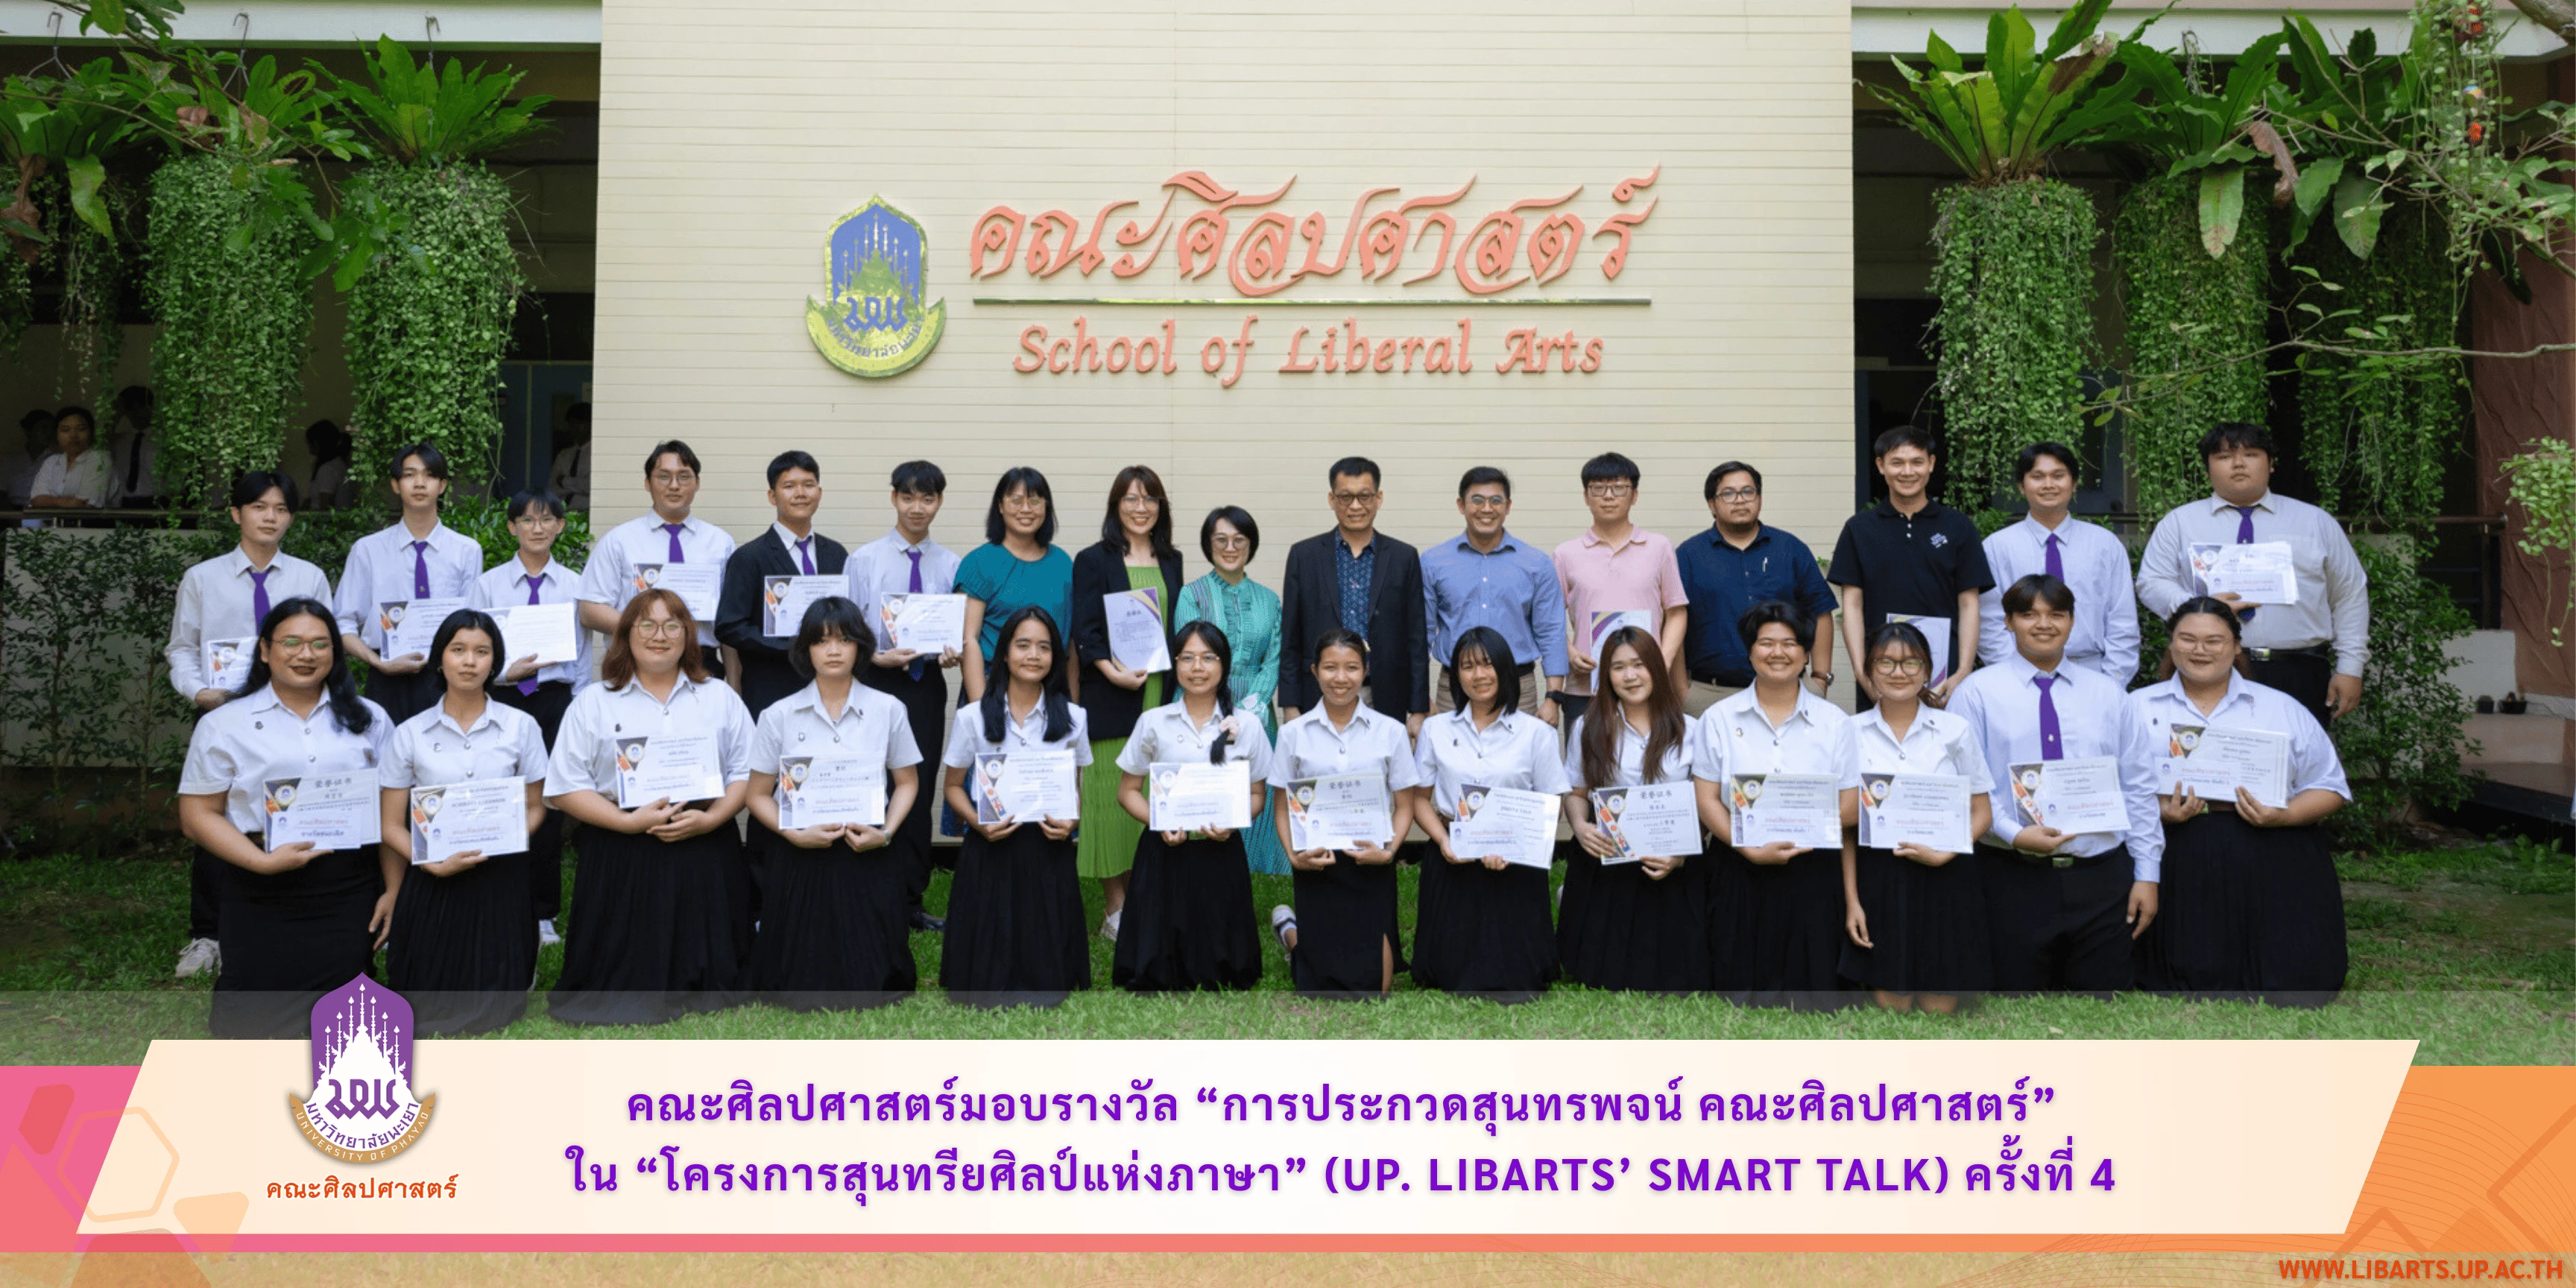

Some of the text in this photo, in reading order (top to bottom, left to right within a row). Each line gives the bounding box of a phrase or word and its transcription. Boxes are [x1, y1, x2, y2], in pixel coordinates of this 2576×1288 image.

[969, 163, 1661, 297] คณะศิลปศาสตร์
[1013, 315, 1605, 387] School of Liberal Arts
